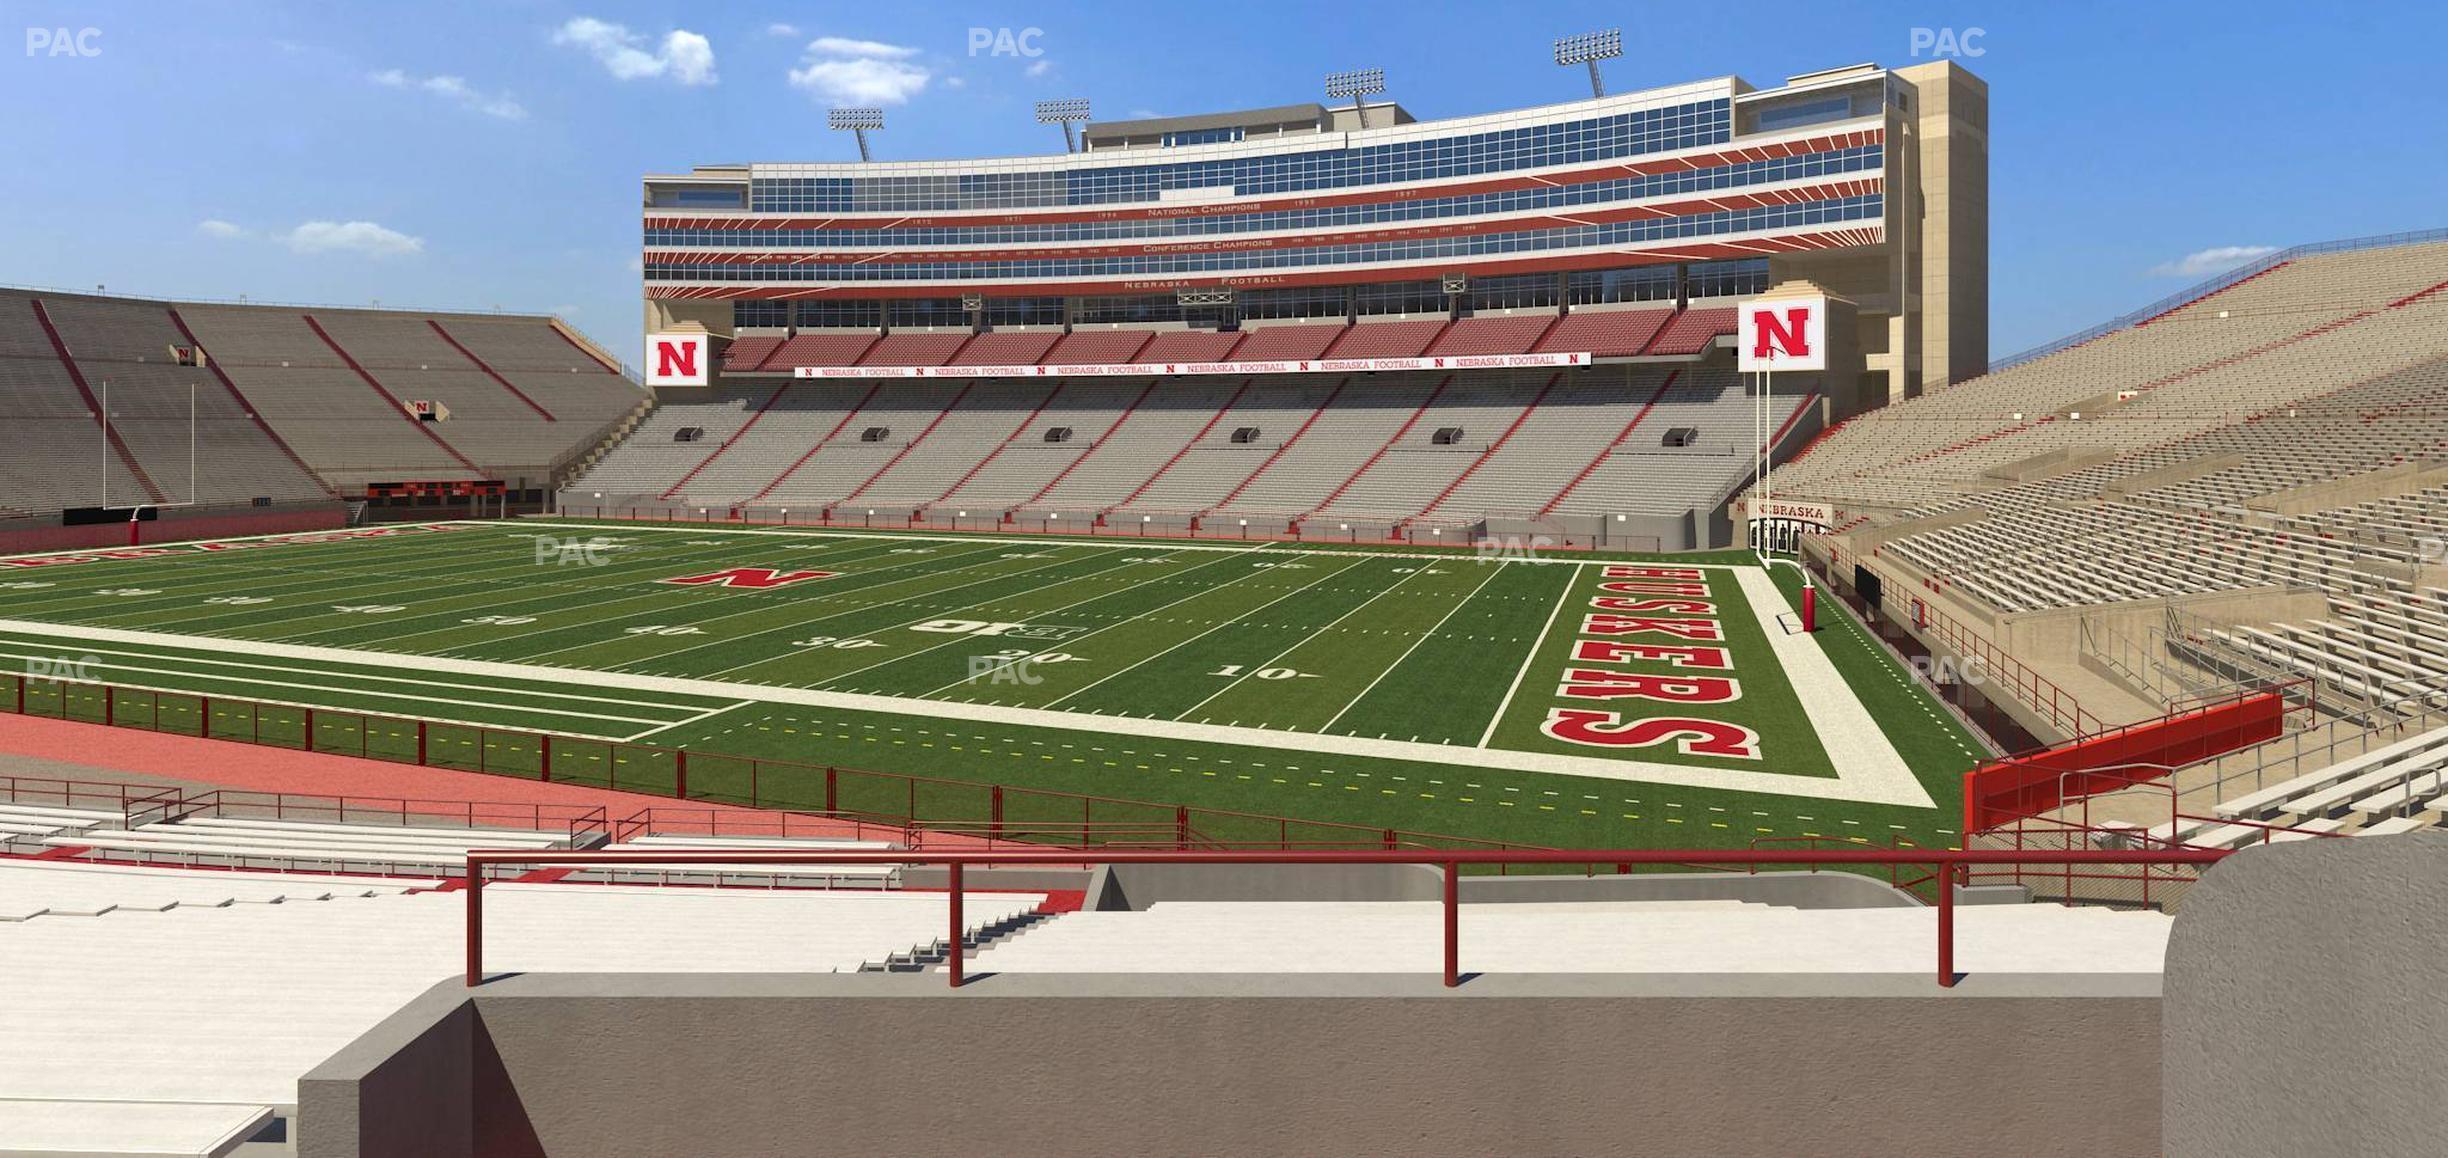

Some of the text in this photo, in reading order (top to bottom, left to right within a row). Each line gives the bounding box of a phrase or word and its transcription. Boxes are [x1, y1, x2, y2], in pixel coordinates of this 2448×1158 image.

[1754, 308, 1809, 358] N
[657, 341, 697, 377] N
[805, 368, 813, 376] N
[865, 368, 905, 376] FOOTBALL
[916, 367, 924, 376] N
[935, 368, 978, 376] NEBRASKA
[982, 367, 1025, 375] FOOTBALL
[1037, 366, 1045, 375] N
[1057, 366, 1103, 375] NEBRASKA
[1107, 365, 1153, 374] FOOTBALL
[1166, 364, 1175, 373] N
[1187, 364, 1235, 373] NEBRASKA
[1239, 363, 1286, 372] FOOTBALL
[1300, 361, 1309, 371] N
[1321, 360, 1369, 370] NEBRASKA
[1374, 359, 1421, 369] FOOTBALL
[1435, 358, 1444, 367] N
[1456, 357, 1505, 367] NEBRASKA
[1509, 355, 1556, 365] FOOTBALL
[1569, 354, 1579, 364] N
[416, 402, 427, 412] N
[653, 568, 845, 588] N
[792, 636, 873, 649] 30
[981, 649, 1072, 663] 20
[1540, 566, 1763, 760] HUSKERS
[1206, 665, 1297, 679] 10
